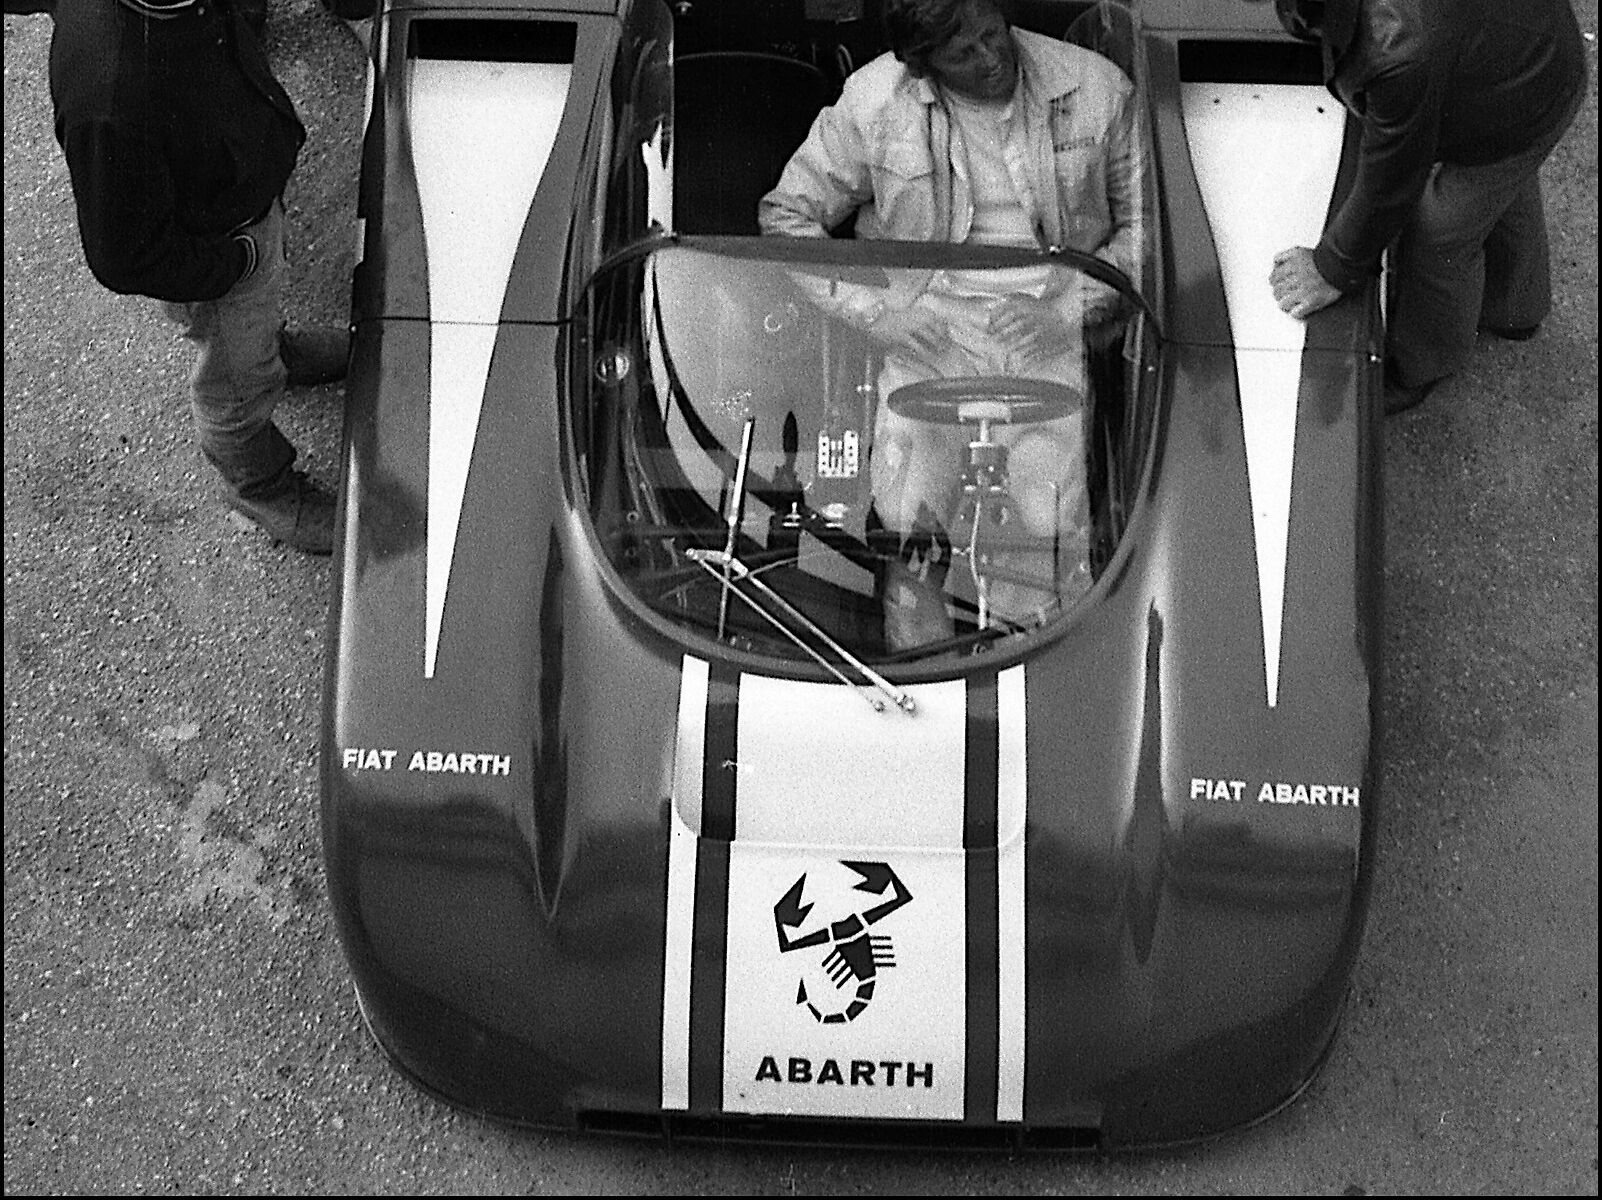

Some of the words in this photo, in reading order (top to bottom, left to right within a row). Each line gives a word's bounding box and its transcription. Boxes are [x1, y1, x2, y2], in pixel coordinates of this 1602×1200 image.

[343, 748, 397, 770] FIAT
[408, 751, 511, 776] ABARTH
[1190, 778, 1246, 800] FIAT
[1258, 782, 1360, 806] ABARTH
[755, 1056, 933, 1088] ABARTH
